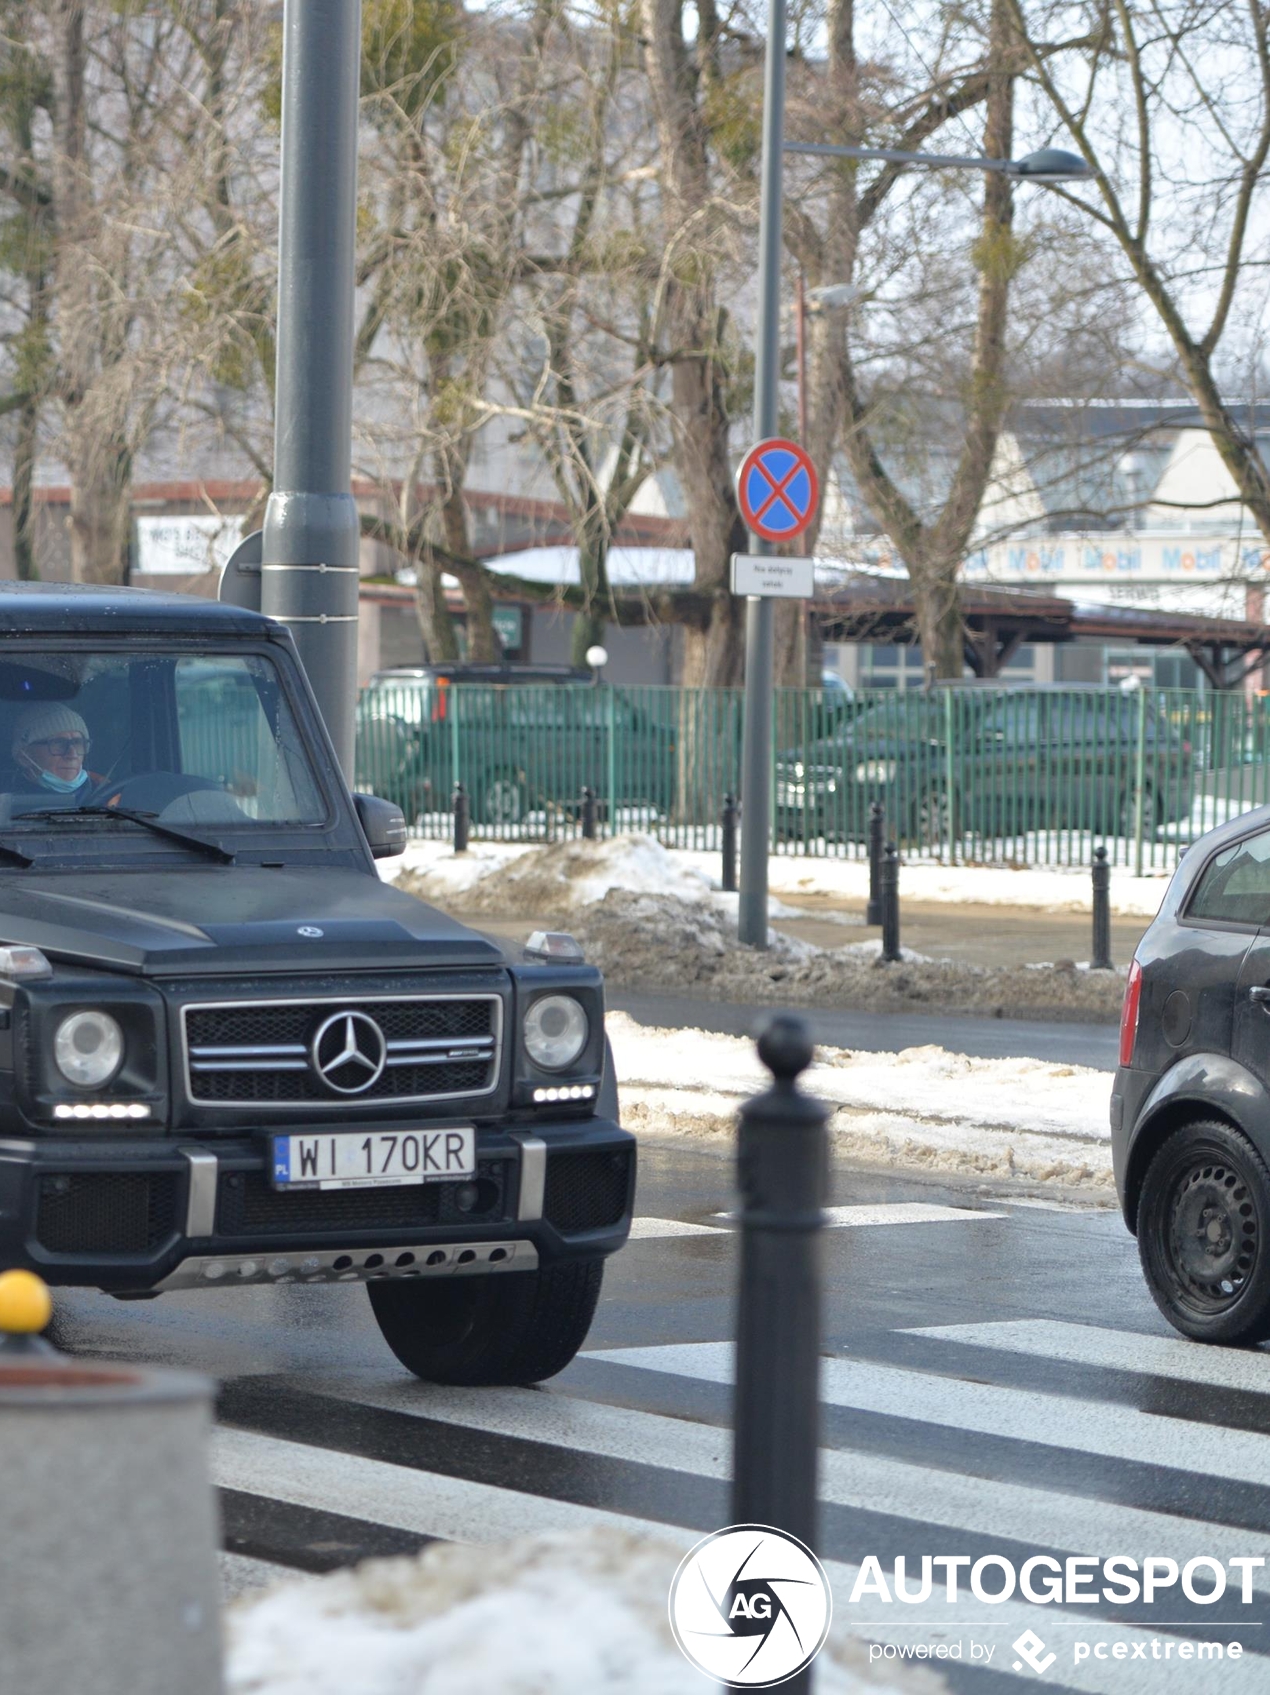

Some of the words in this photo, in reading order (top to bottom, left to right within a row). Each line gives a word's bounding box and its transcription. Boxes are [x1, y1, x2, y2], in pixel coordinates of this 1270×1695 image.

[299, 1138, 336, 1177] WI
[361, 1133, 465, 1174] 170KR
[275, 1165, 288, 1175] PL
